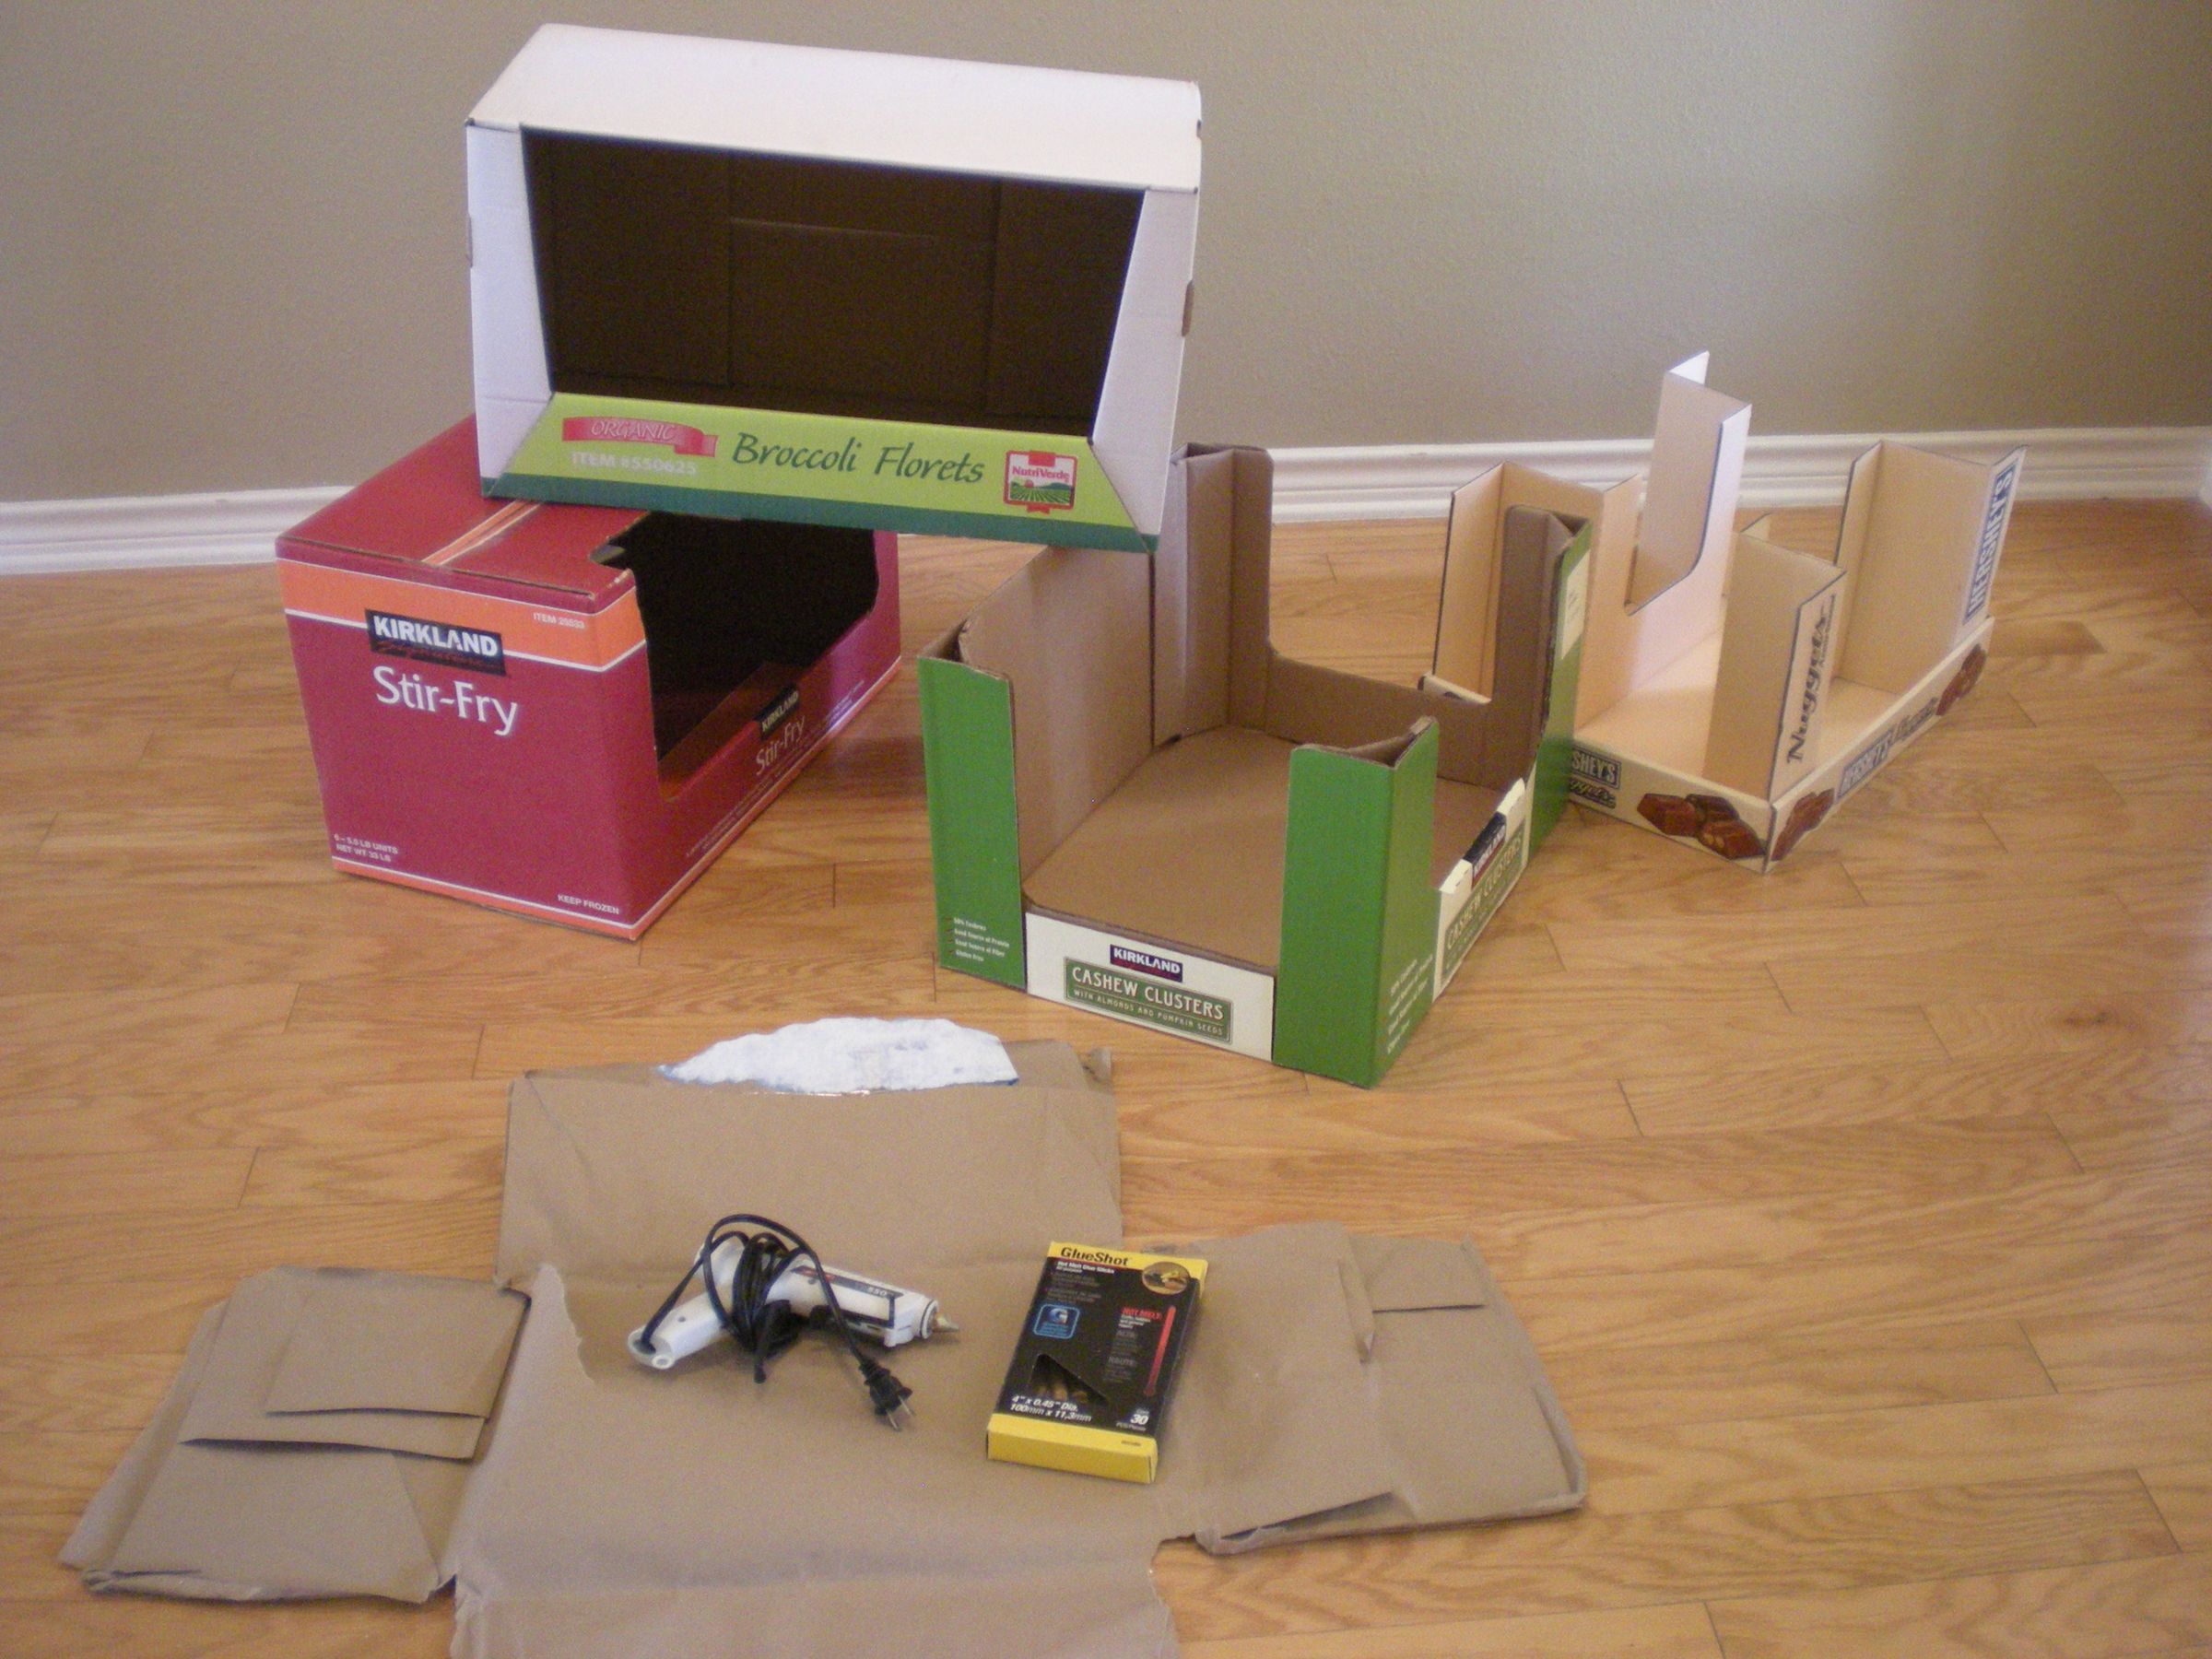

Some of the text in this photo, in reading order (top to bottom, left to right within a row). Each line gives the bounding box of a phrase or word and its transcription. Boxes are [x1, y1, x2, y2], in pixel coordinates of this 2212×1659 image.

[591, 420, 677, 441] ORGANIC
[571, 452, 616, 467] ITEM
[733, 432, 985, 484] Broccoli Florets
[533, 612, 557, 624] ITEM
[372, 615, 500, 657] KIRKLAND
[373, 665, 518, 735] Stir-Fry
[761, 691, 799, 732] KIRKLAND
[756, 715, 806, 776] Stir-Fry
[1571, 750, 1617, 783] SHEY'S
[372, 842, 398, 855] UNITS
[558, 894, 619, 914] KEEP FROZEN
[1113, 947, 1181, 974] KIRKLAND
[1072, 966, 1138, 997] CASHEW
[1145, 986, 1224, 1020] CLUSTERS
[1074, 988, 1223, 1036] WITH ALMONDS AND PUMPKIN SEEDS
[1061, 1247, 1129, 1265] GlueShot
[1010, 1404, 1044, 1415] 100mm
[1130, 1414, 1149, 1425] 30
